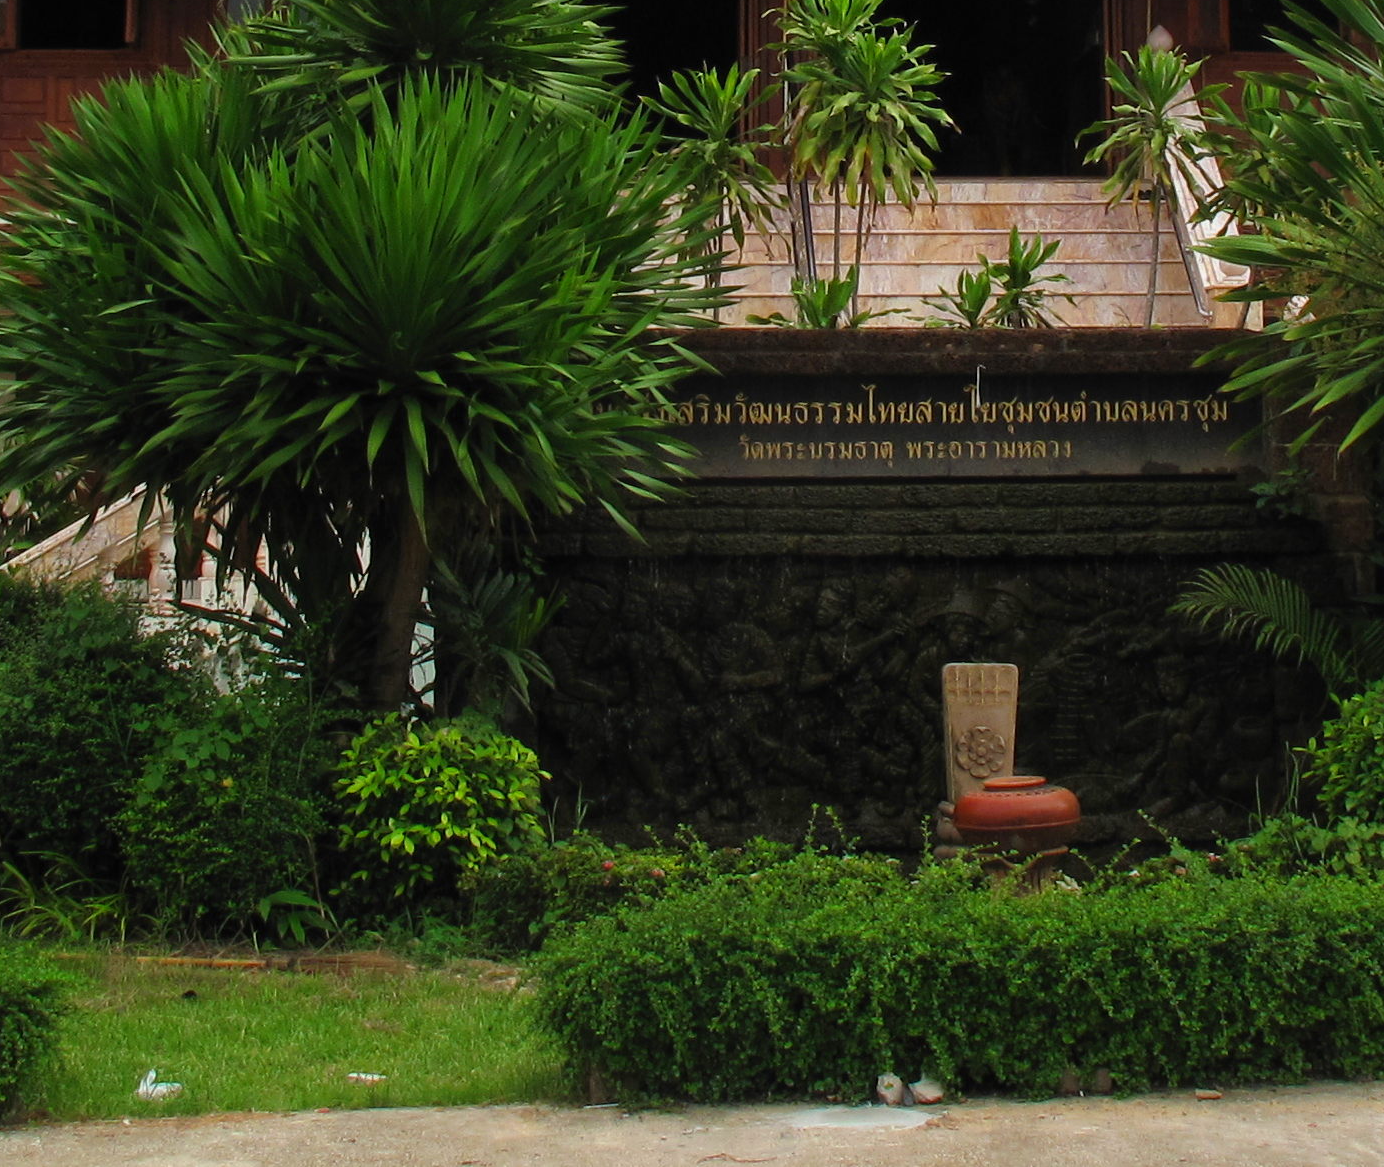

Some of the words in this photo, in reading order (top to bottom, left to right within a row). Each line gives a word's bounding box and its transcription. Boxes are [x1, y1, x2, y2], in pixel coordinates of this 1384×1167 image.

[738, 433, 896, 468] วัดพระบรมธาตุ
[905, 439, 1075, 462] พระอารามหลวง
